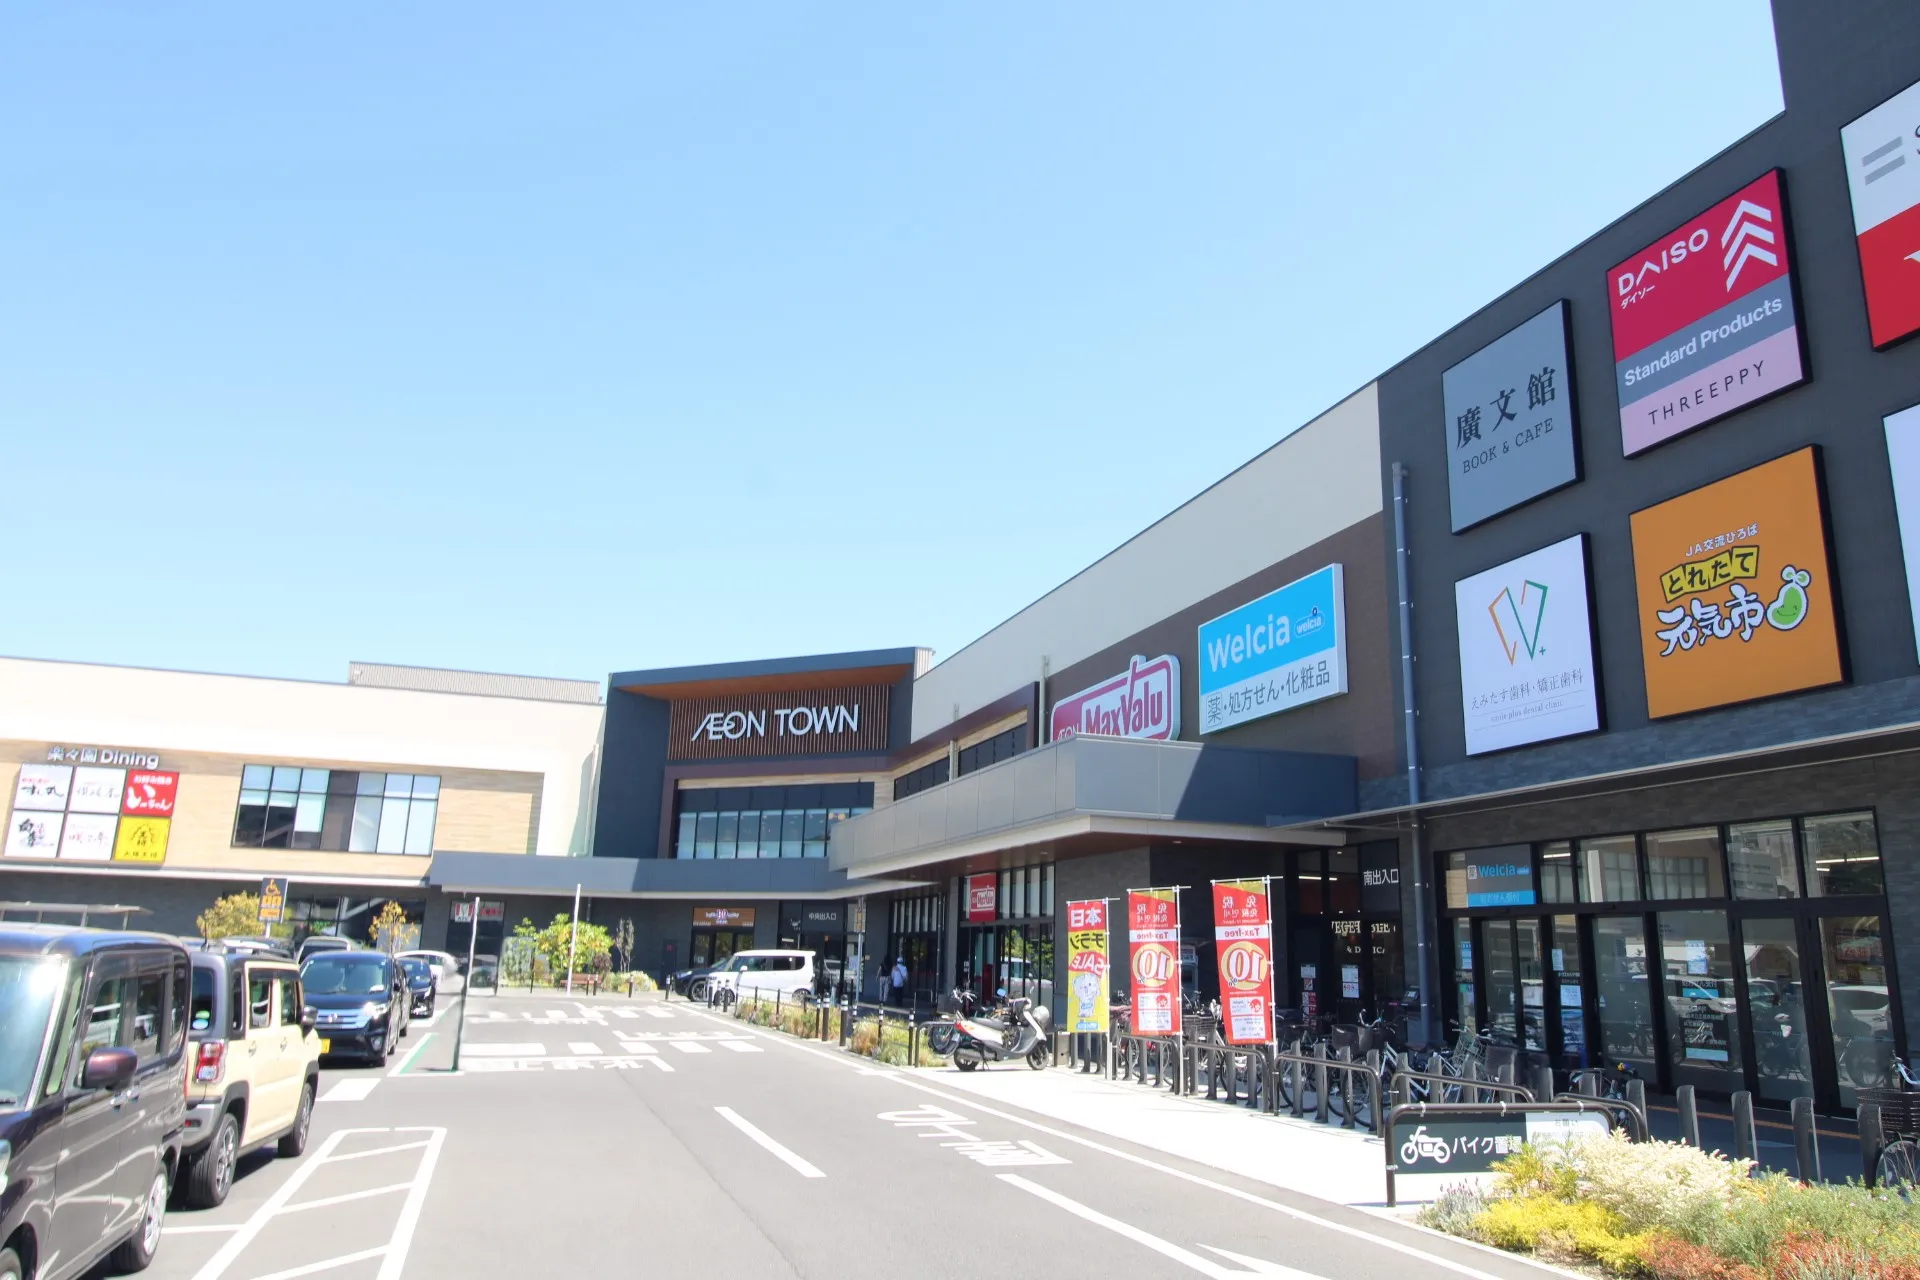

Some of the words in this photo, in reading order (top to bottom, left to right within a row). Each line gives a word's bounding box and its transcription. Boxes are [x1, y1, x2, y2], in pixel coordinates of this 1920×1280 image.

[1617, 227, 1710, 297] DAISO
[1620, 284, 1656, 310] ダイソー
[1624, 335, 1698, 387] Standard
[1700, 296, 1784, 357] Products
[1455, 366, 1557, 451] 廣文館
[1647, 360, 1767, 426] THREEPPY
[1461, 444, 1498, 475] BOOK
[1502, 439, 1511, 455] &
[1515, 416, 1555, 446] CAFE
[1685, 522, 1759, 558] JA交流ひろば
[1664, 549, 1757, 599] とれたて
[1206, 614, 1292, 673] Welcia
[1656, 584, 1765, 657] 元気市
[774, 704, 860, 737] TOWN
[1086, 660, 1163, 736] MaxValu
[1508, 708, 1522, 721] plus
[1523, 702, 1544, 716] dental
[1545, 699, 1564, 711] clinic
[101, 749, 160, 770] Dining
[1363, 868, 1400, 886] 南出入口
[1478, 863, 1516, 878] Welcia
